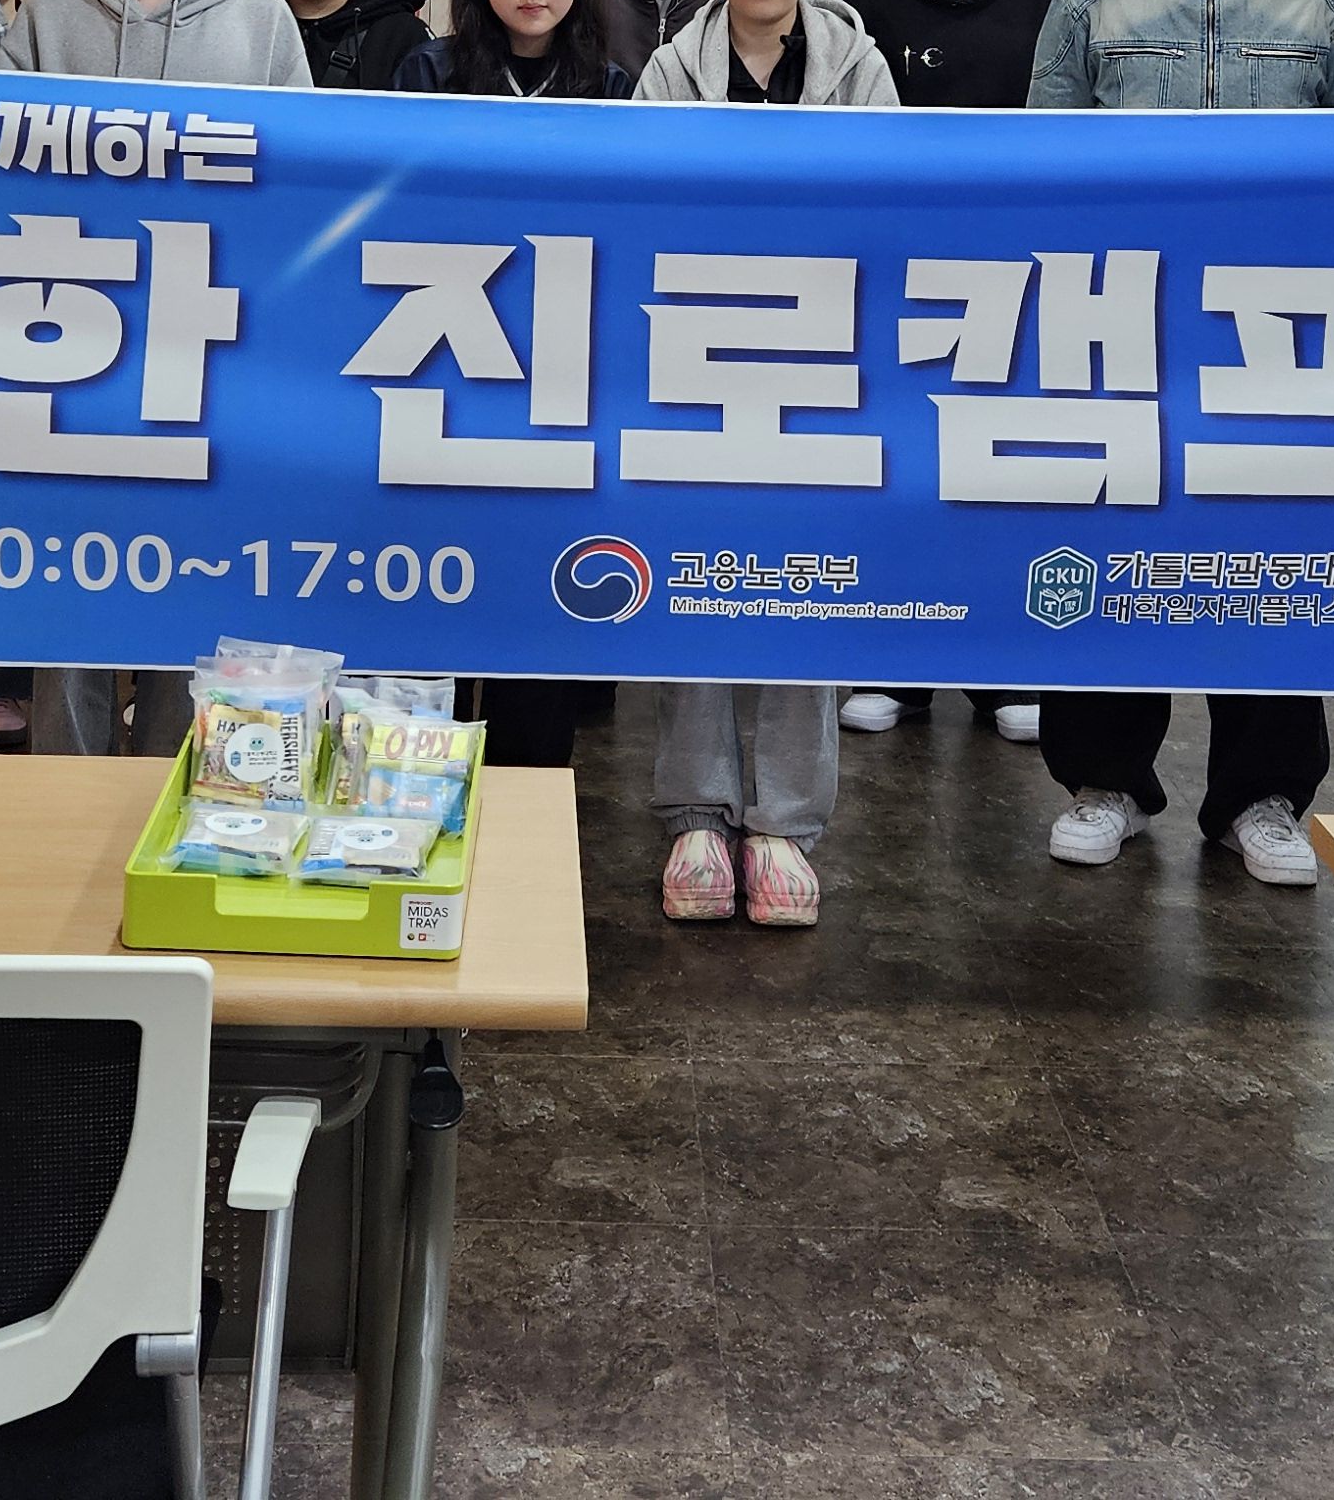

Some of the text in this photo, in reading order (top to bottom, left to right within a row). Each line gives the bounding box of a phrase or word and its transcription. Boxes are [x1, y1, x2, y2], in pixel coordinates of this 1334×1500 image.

[668, 550, 859, 593] 고용노동부
[1042, 567, 1084, 584] CKU
[670, 596, 968, 621] Ministry of Employment and Labor
[408, 906, 449, 918] MIDAS
[408, 917, 439, 929] TRAY
